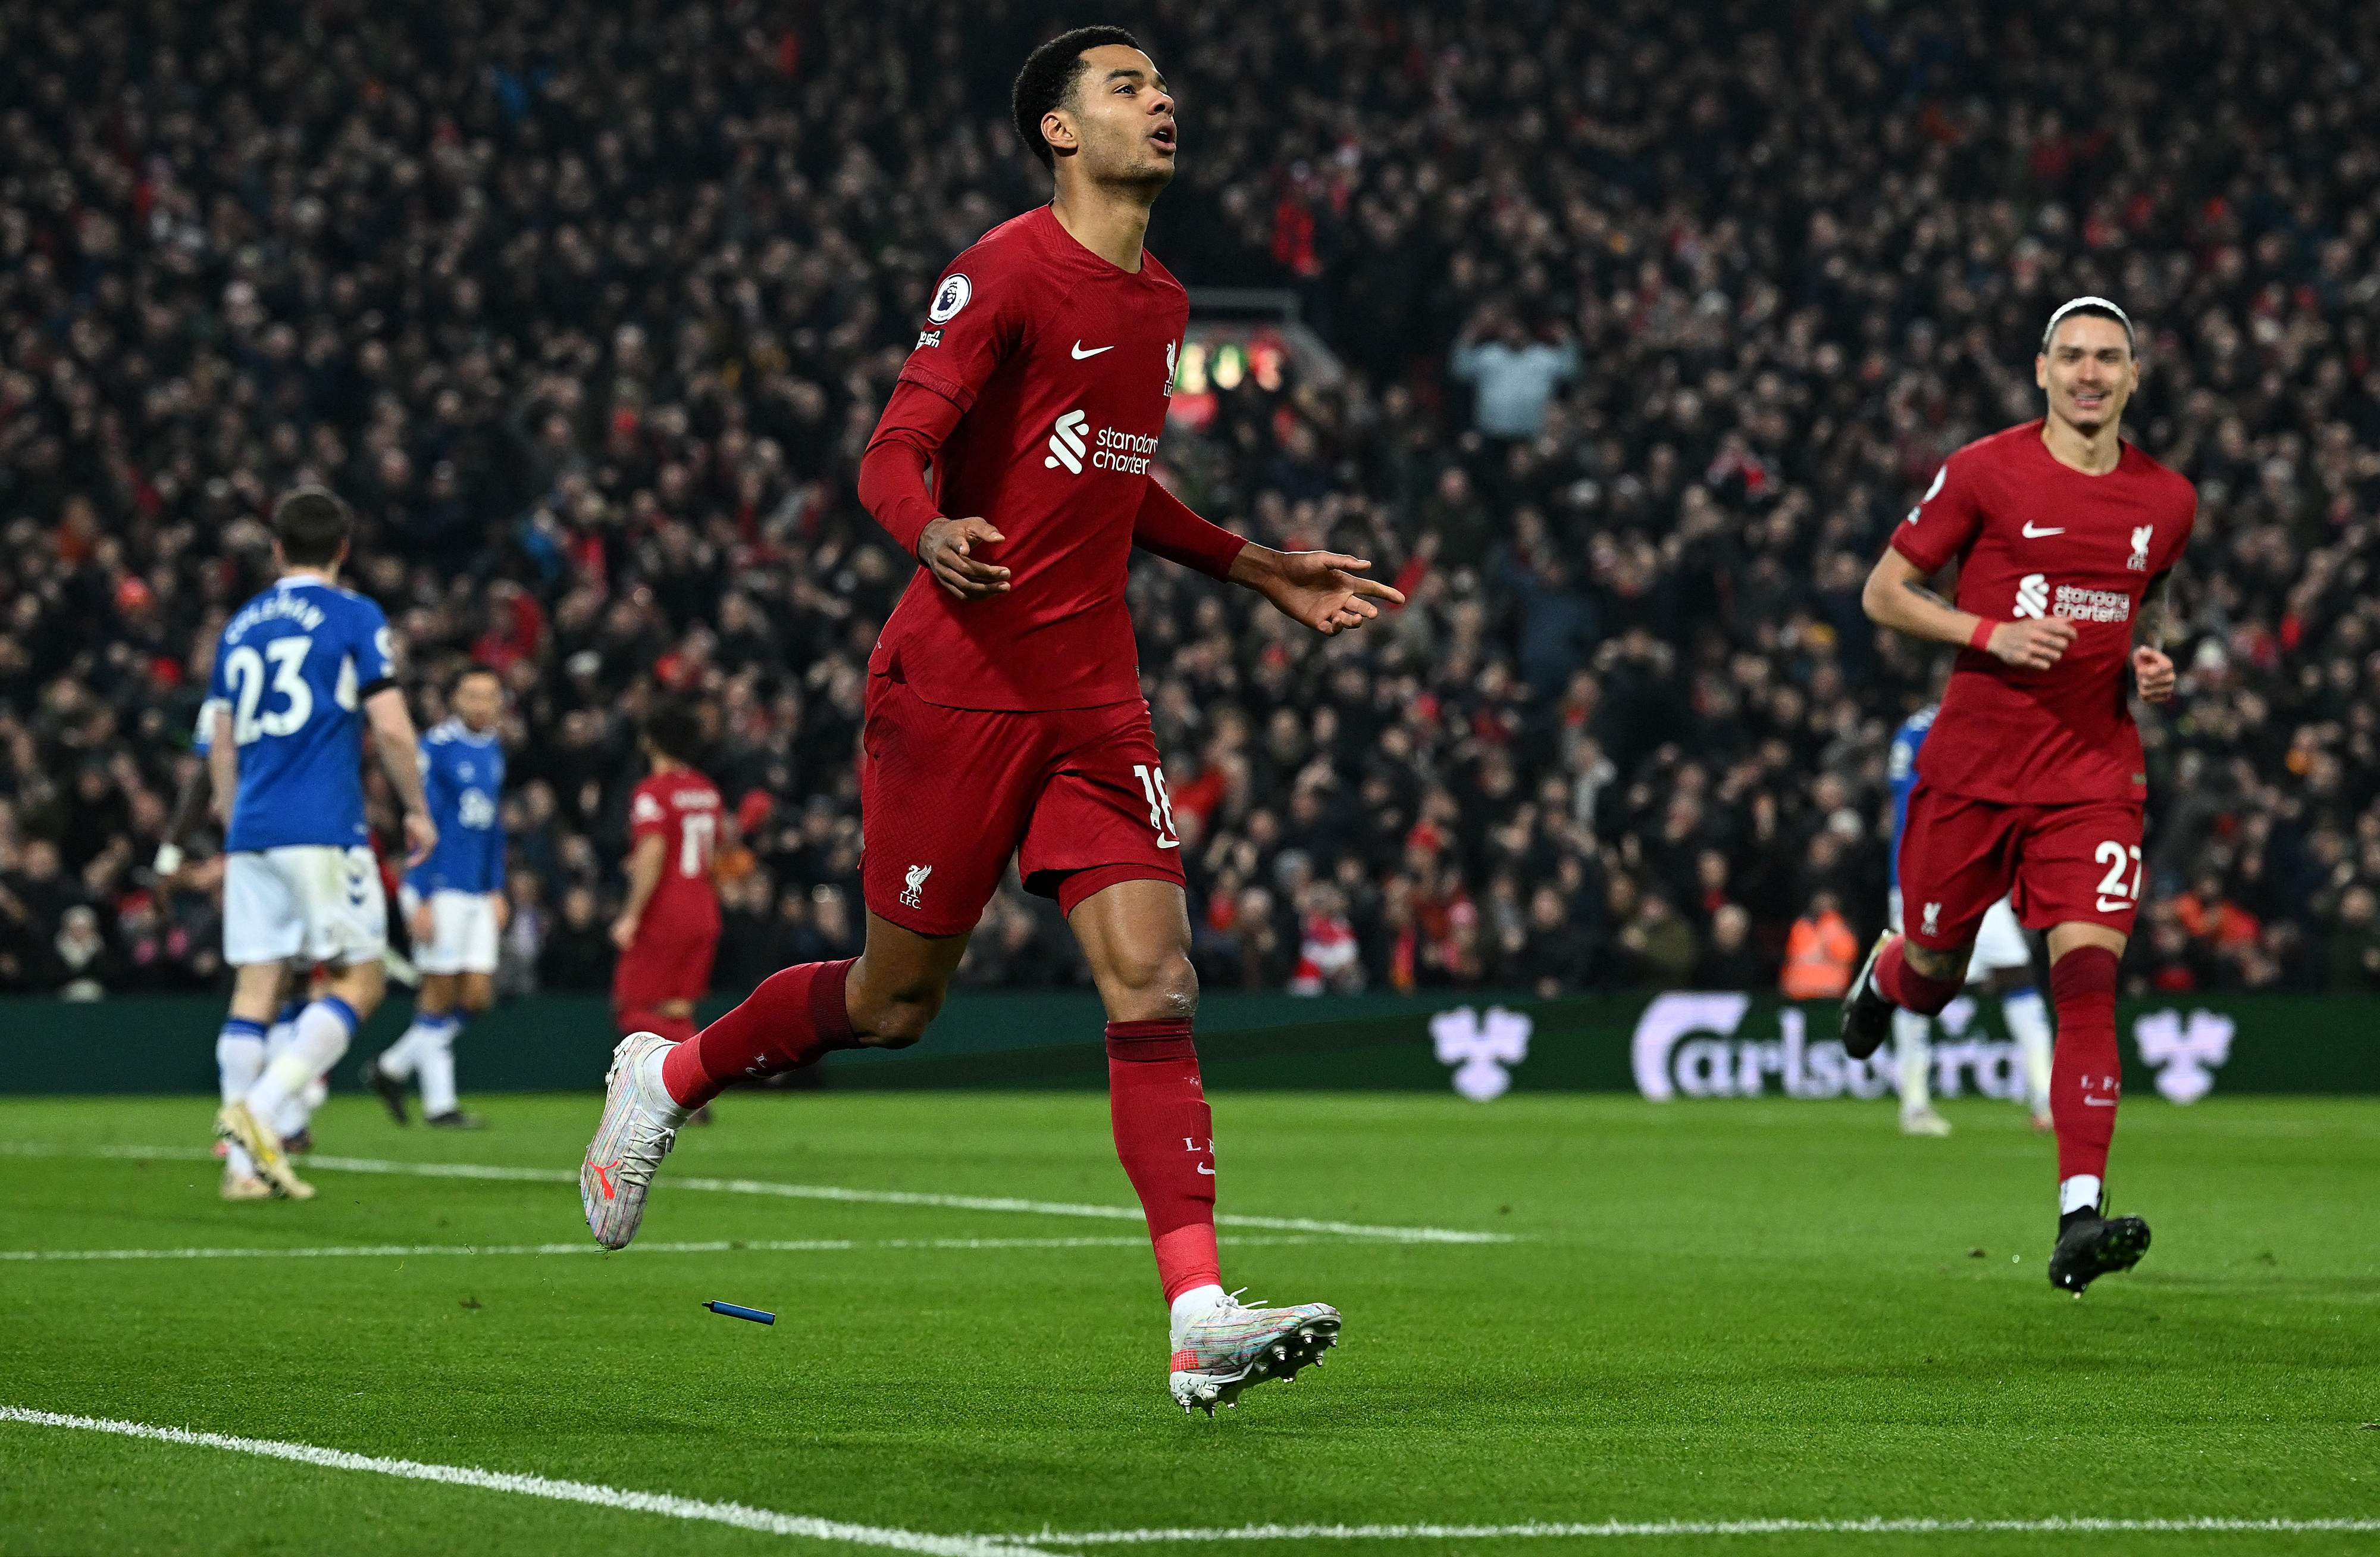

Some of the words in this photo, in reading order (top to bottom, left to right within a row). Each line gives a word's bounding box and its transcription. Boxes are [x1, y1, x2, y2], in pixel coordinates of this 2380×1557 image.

[1096, 426, 1158, 454] standar
[224, 634, 314, 746] 23
[1631, 990, 2031, 1101] Carlsbrg
